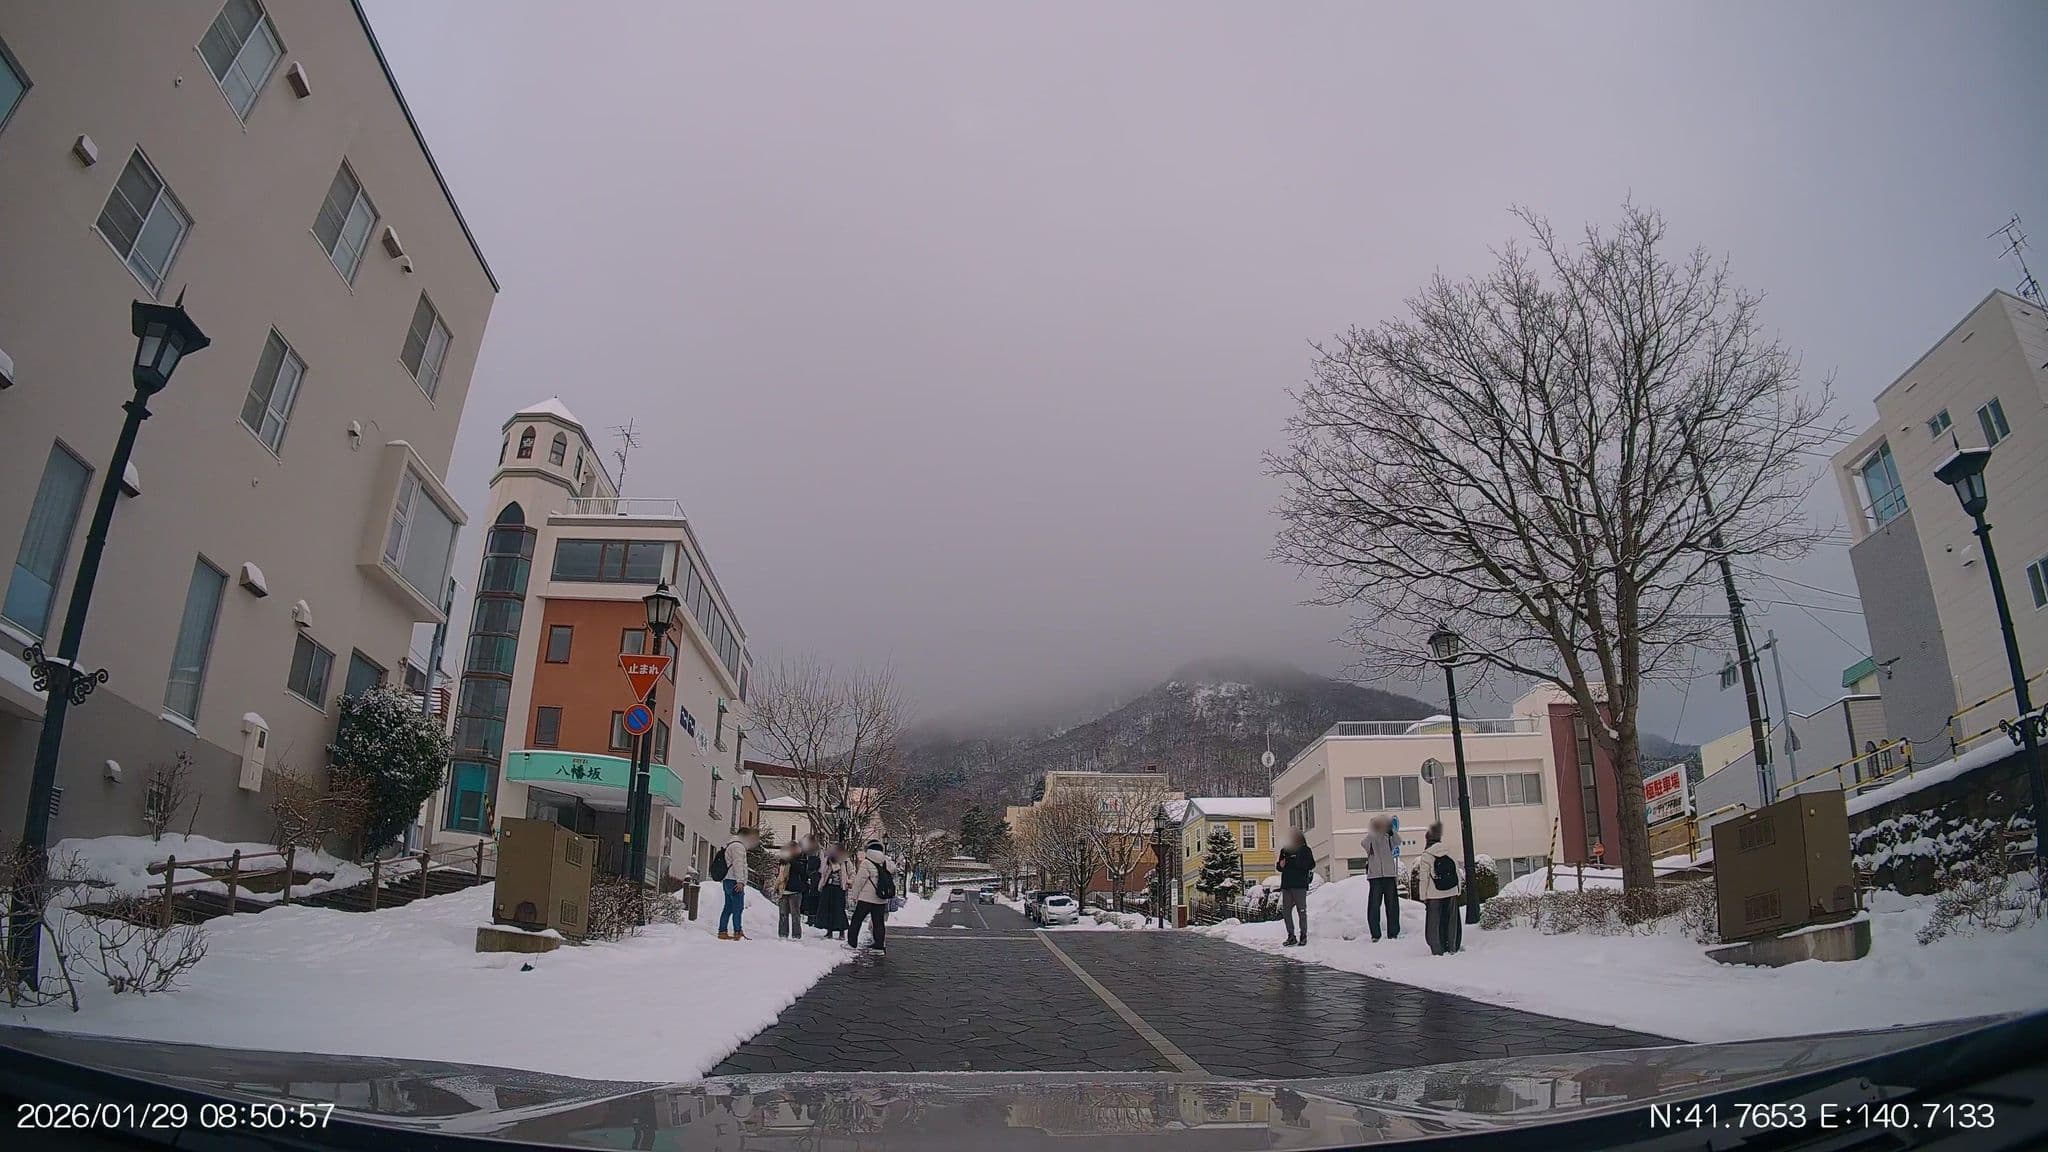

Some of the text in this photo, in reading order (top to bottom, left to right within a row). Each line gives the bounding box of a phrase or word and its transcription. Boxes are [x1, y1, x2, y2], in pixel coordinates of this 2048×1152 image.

[628, 663, 660, 675] 止まれ
[555, 764, 603, 781] 八幡坂
[1643, 771, 1680, 800] 極駐車場
